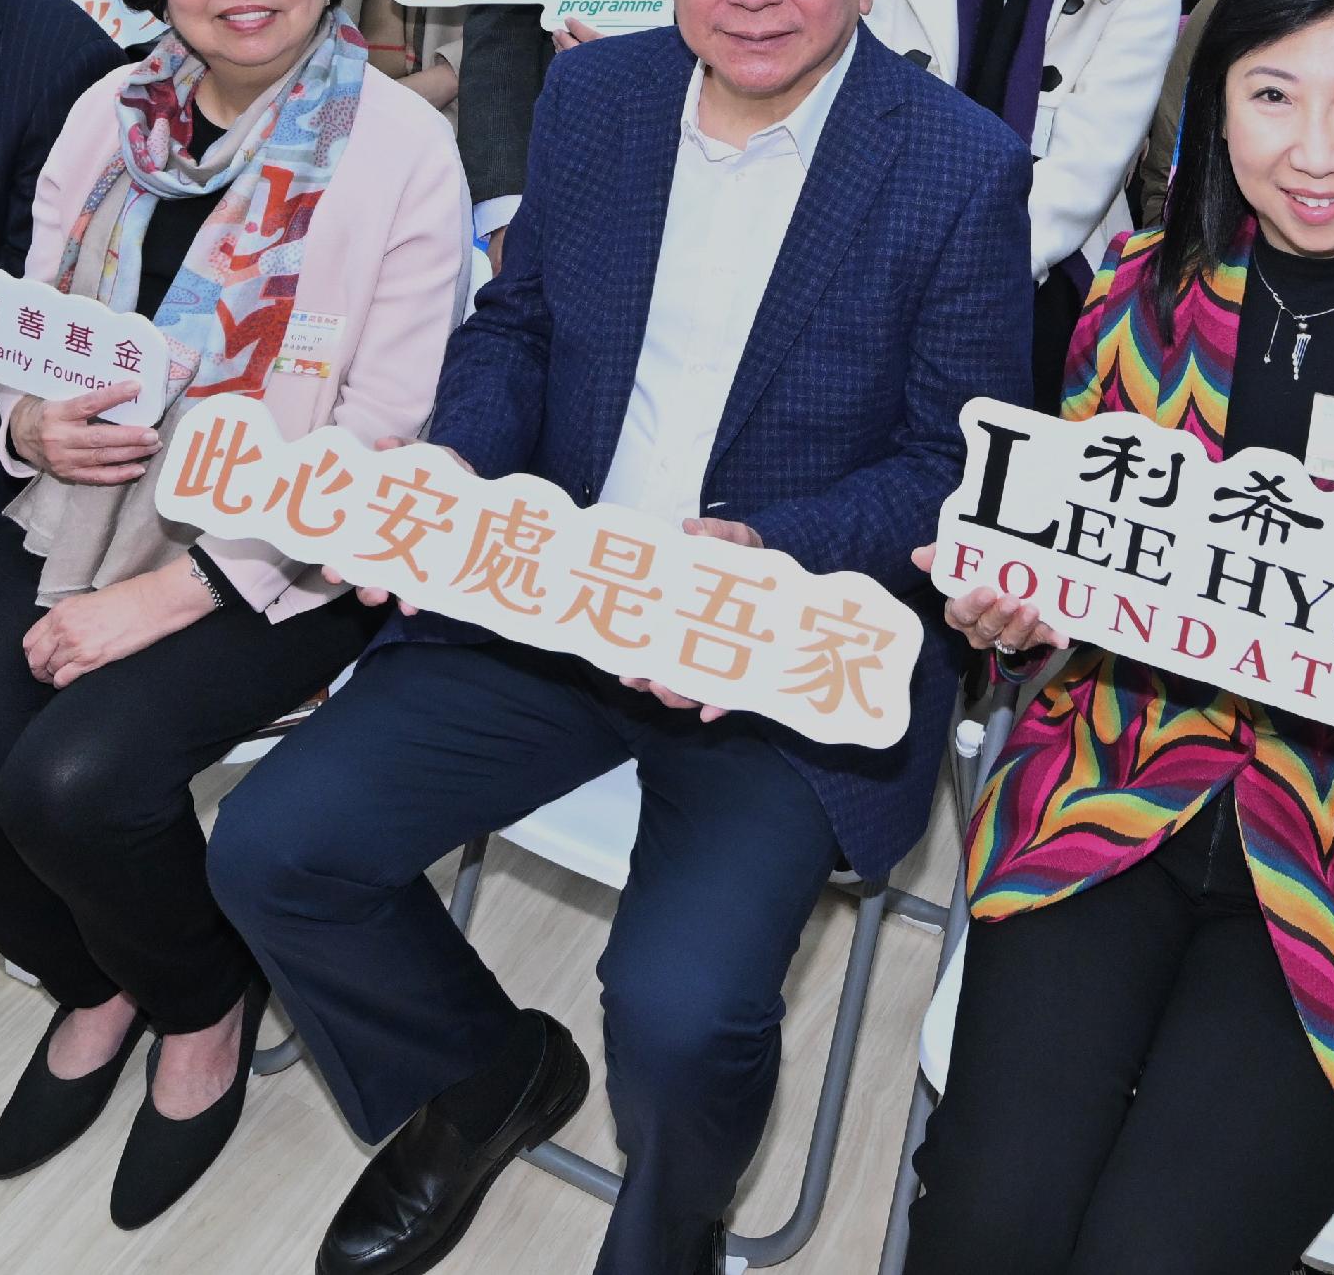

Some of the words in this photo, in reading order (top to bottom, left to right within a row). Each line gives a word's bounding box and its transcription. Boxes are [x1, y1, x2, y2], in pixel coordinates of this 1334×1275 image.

[557, 0, 663, 16] programme
[175, 416, 897, 720] 此心安處是吾家
[958, 420, 1177, 587] LEE
